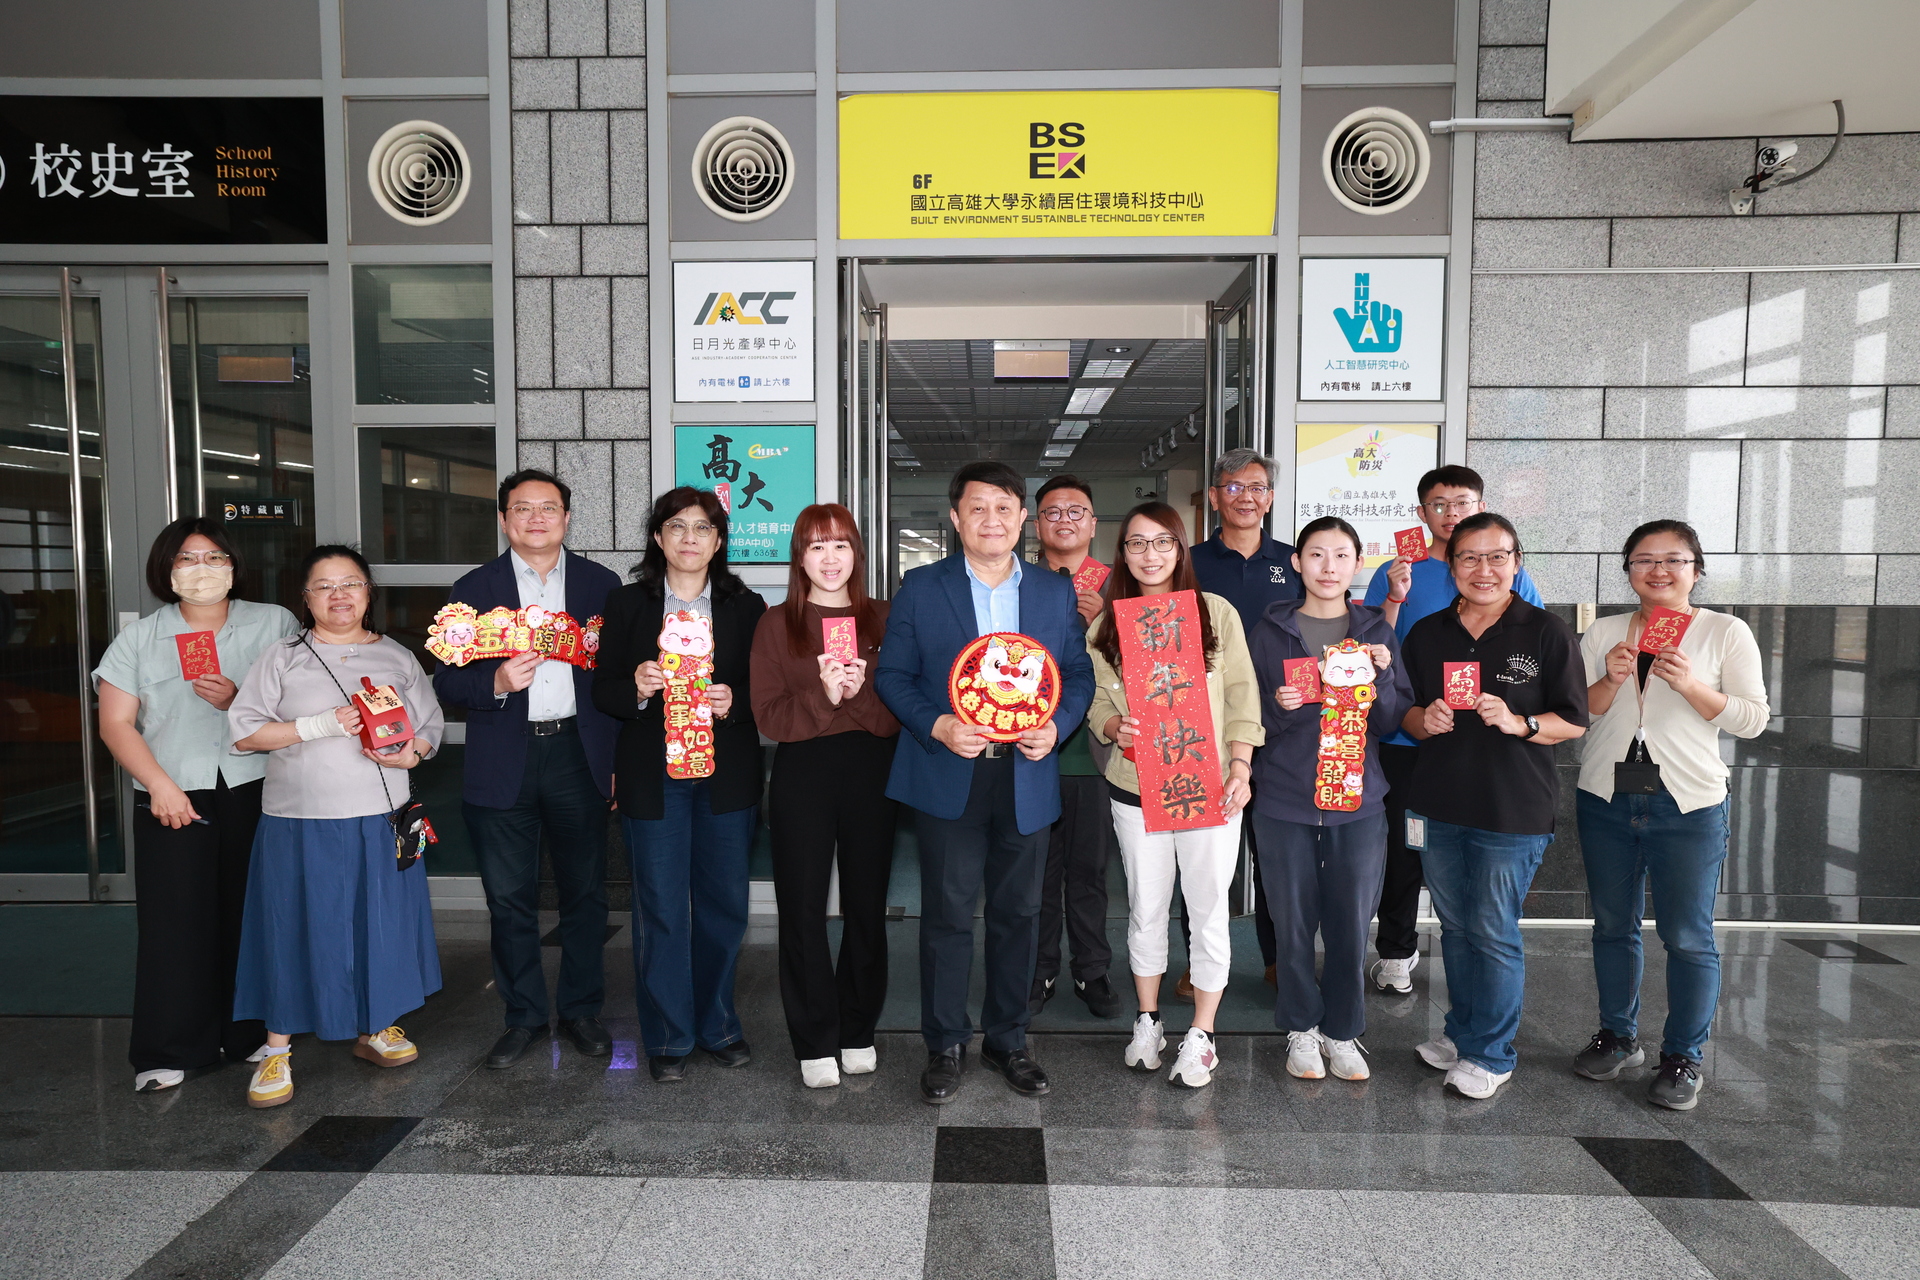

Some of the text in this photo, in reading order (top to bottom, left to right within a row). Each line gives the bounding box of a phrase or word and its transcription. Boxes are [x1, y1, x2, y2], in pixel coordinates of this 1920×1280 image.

[215, 146, 272, 160] School
[29, 143, 196, 199] 校史室
[216, 165, 280, 181] History
[913, 174, 932, 189] 6F
[217, 183, 266, 197] Room
[911, 192, 1204, 211] 國立高雄大學永續居住環境科技中心
[911, 213, 1205, 225] BUILT ENVIRONMENT SUSTAINBLE TECHNOLOGY CENTER
[692, 337, 797, 351] 日月光產學中心
[1324, 359, 1410, 371] 人工智慧研究中心
[754, 377, 791, 387] 請上六樓
[1320, 381, 1412, 392] 內有電梯 請上六樓
[1353, 447, 1378, 459] 高大
[1358, 460, 1383, 471] 防災
[1343, 490, 1397, 501] 國立高雄大學
[241, 504, 284, 515] 特藏區
[1300, 503, 1417, 518] 災害防救科技研究中
[727, 538, 775, 547] MBA中心)
[754, 549, 779, 558] 636室
[477, 627, 577, 658] 五福臨門
[1448, 686, 1467, 695] 2026
[1135, 598, 1208, 820] 新年快樂
[667, 677, 712, 777] 萬事如意
[1319, 709, 1366, 808] 恭喜發財
